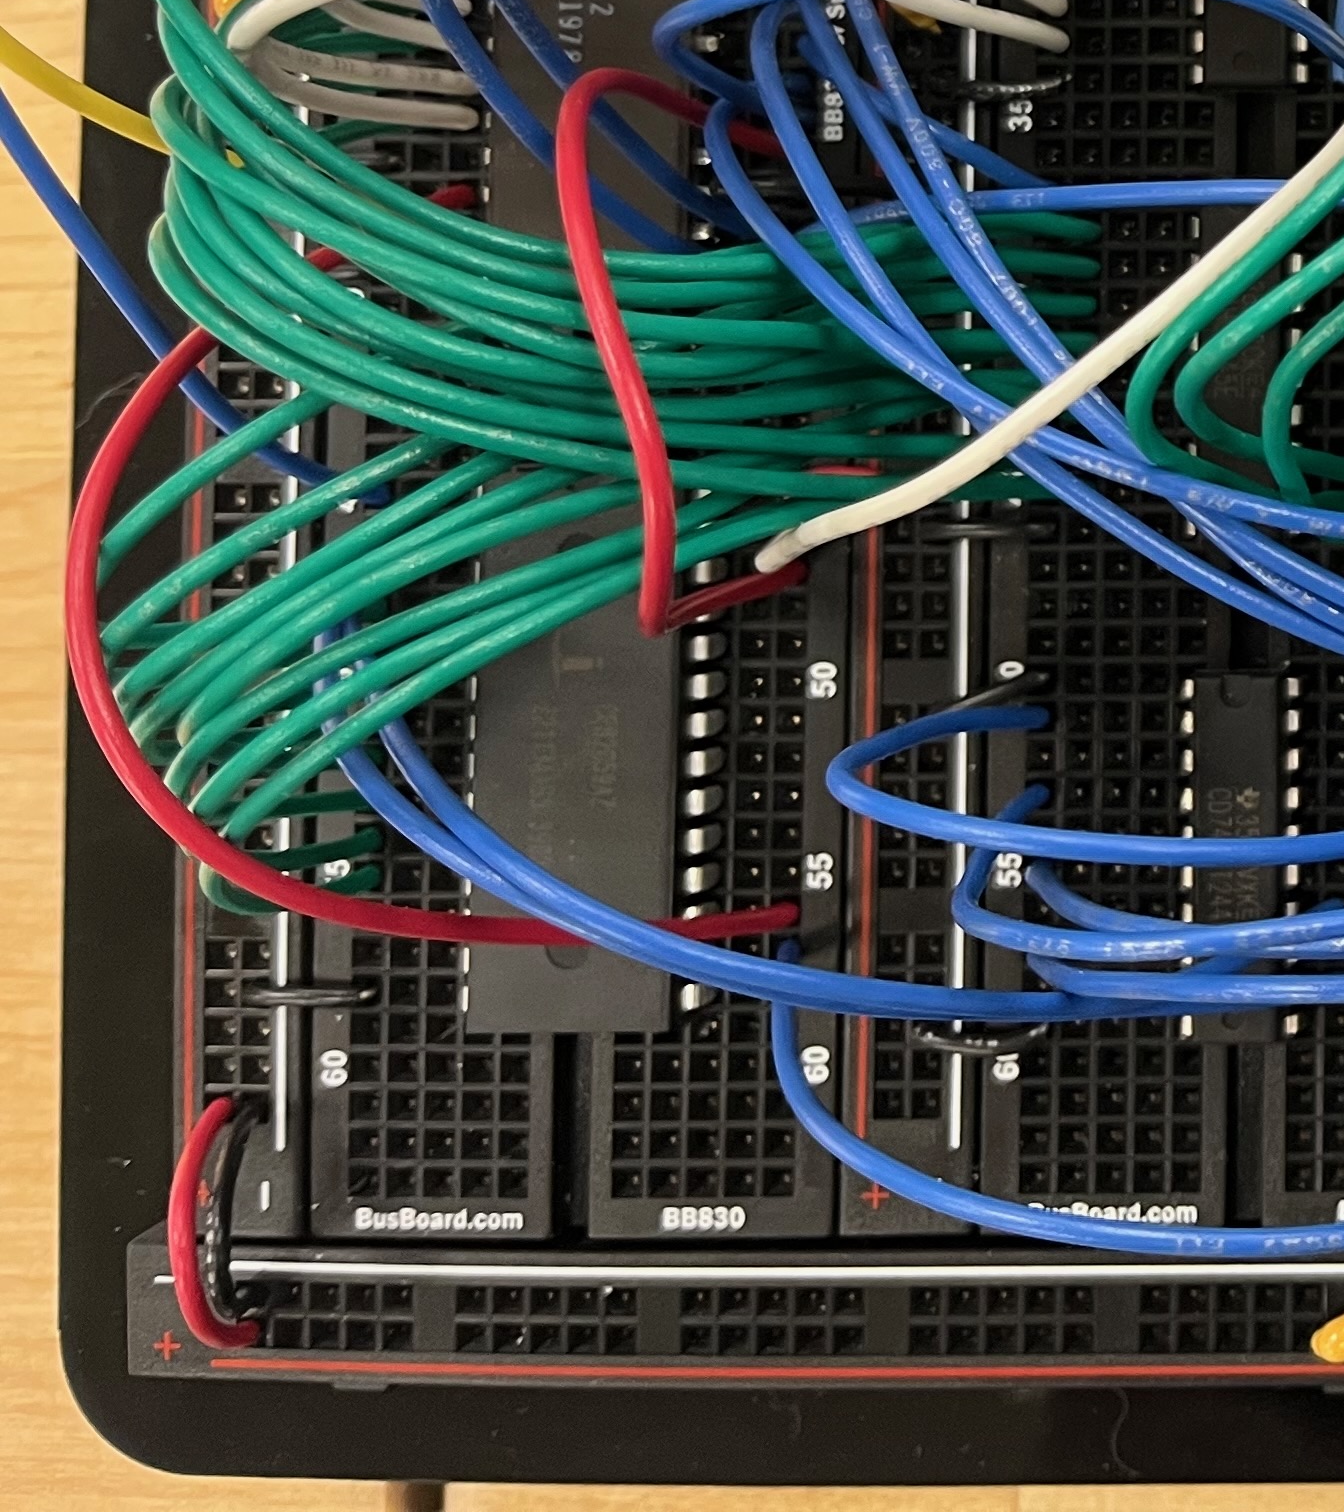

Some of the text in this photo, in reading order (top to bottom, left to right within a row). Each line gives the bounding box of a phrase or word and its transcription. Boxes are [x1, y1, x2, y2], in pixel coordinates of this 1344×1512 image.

[1008, 98, 1034, 133] 35
[805, 661, 838, 699] 50
[804, 852, 834, 890] 55
[998, 852, 1024, 888] 55
[320, 1048, 349, 1088] 60
[801, 1045, 832, 1085] 60
[354, 1206, 525, 1232] BusBoard.com
[660, 1206, 747, 1231] BB830
